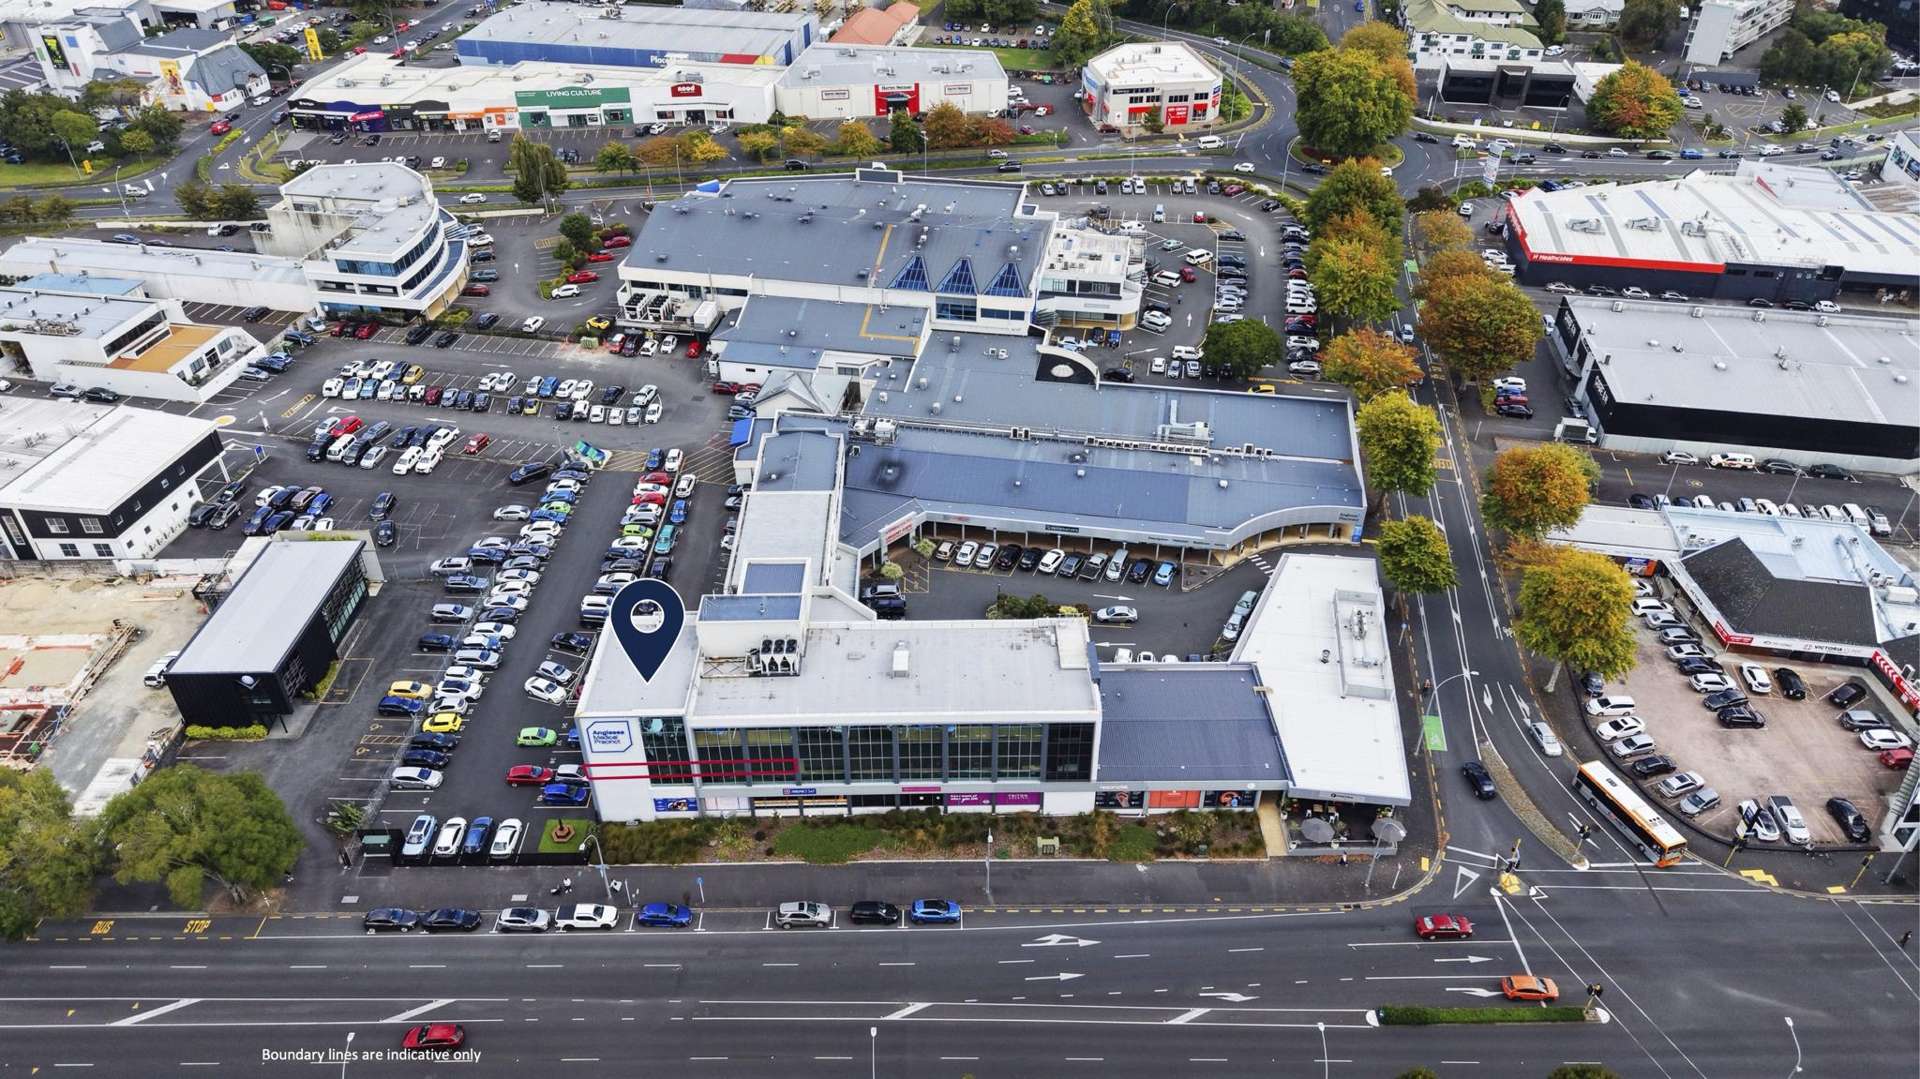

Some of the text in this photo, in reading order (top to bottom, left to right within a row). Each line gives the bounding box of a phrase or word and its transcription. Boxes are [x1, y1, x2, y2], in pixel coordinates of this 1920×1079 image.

[570, 88, 602, 96] CULTURE
[91, 920, 212, 934] BUS STOP
